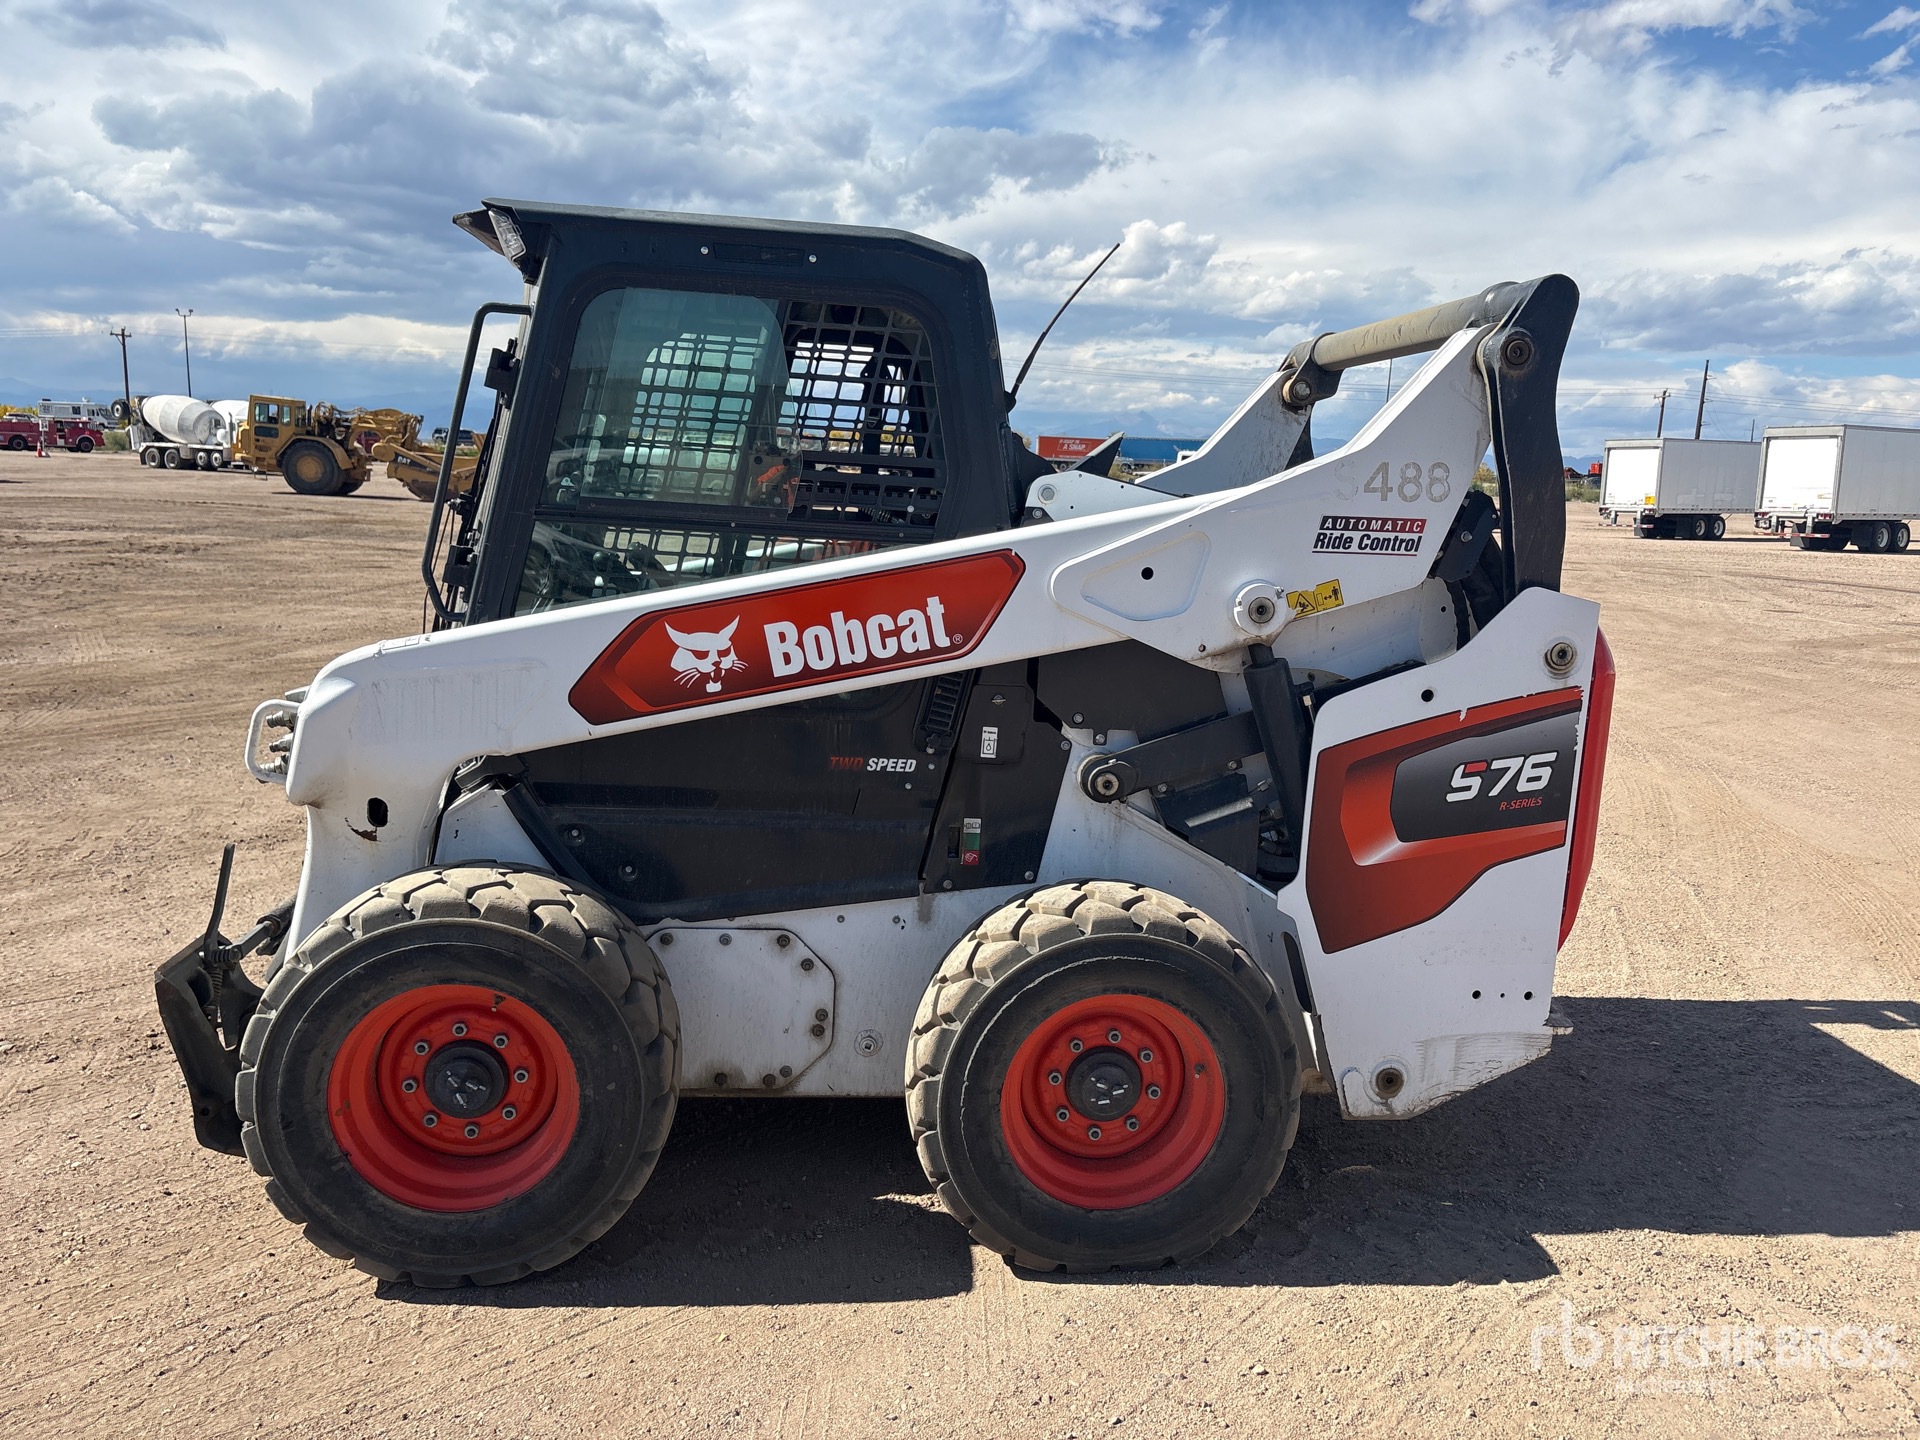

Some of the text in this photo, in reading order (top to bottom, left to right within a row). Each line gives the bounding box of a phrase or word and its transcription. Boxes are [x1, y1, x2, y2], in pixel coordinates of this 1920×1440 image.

[397, 455, 411, 465] CAT
[1323, 518, 1423, 533] AUTOMATIC
[1313, 532, 1423, 553] Ride Control
[763, 596, 951, 678] Bobcat
[830, 756, 917, 773] TWO SPEED
[1446, 752, 1558, 802] S76
[1499, 796, 1543, 811] R-SERIES
